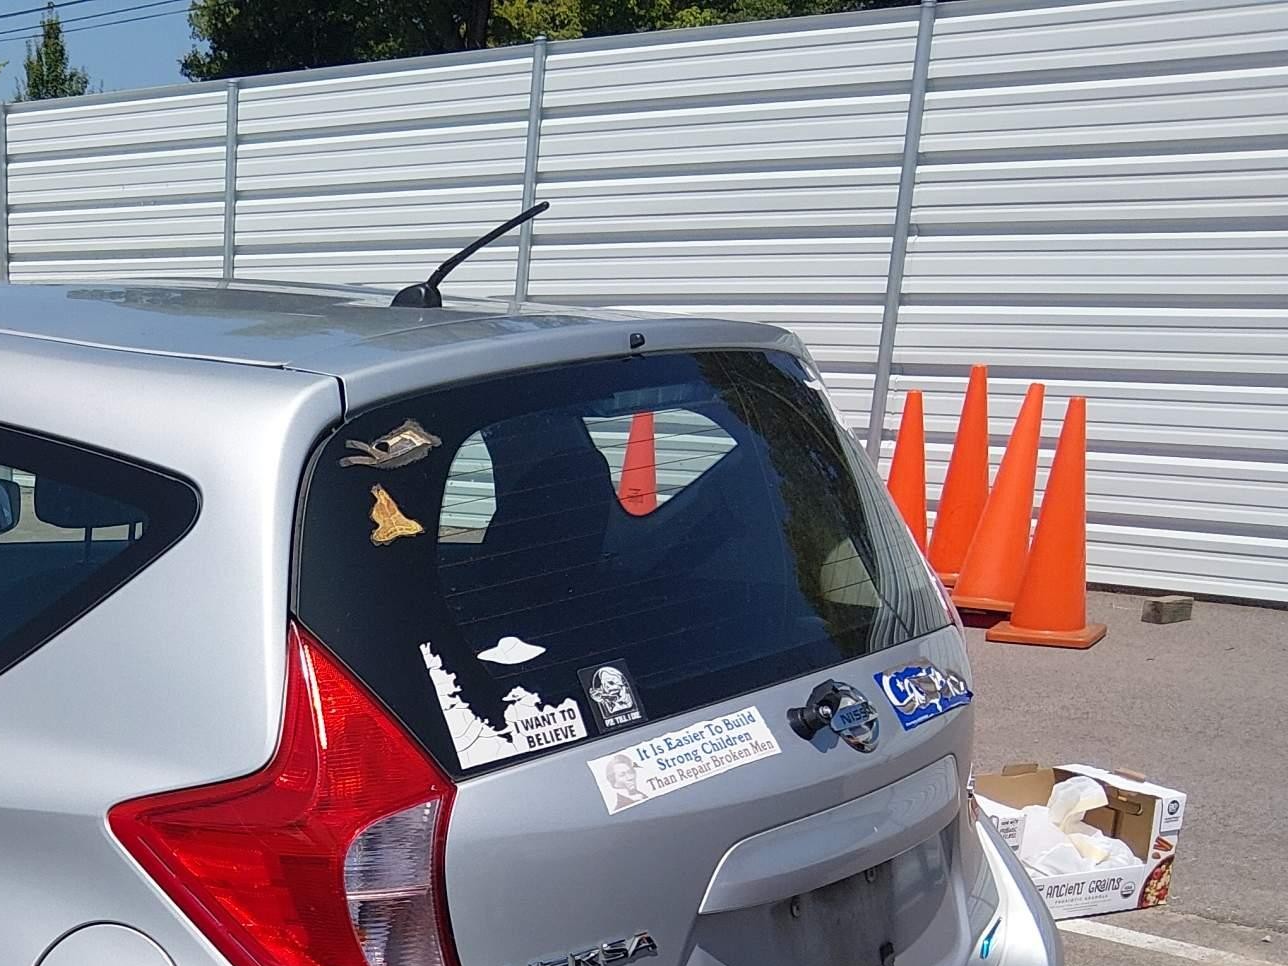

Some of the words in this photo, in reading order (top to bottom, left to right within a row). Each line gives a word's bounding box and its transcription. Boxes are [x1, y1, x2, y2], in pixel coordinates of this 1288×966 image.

[513, 721, 521, 734] I
[523, 710, 559, 731] WANT
[559, 707, 577, 723] TO
[526, 725, 577, 749] BELIEVE
[636, 747, 650, 762] It
[651, 743, 665, 758] Is
[664, 729, 706, 750] Easier
[705, 721, 724, 737] To
[724, 711, 756, 731] Build
[646, 774, 678, 791] Than
[677, 761, 712, 783] Repair
[713, 748, 751, 767] Broken
[750, 739, 775, 756] Men
[657, 749, 699, 771] Strong
[701, 731, 753, 755] Children
